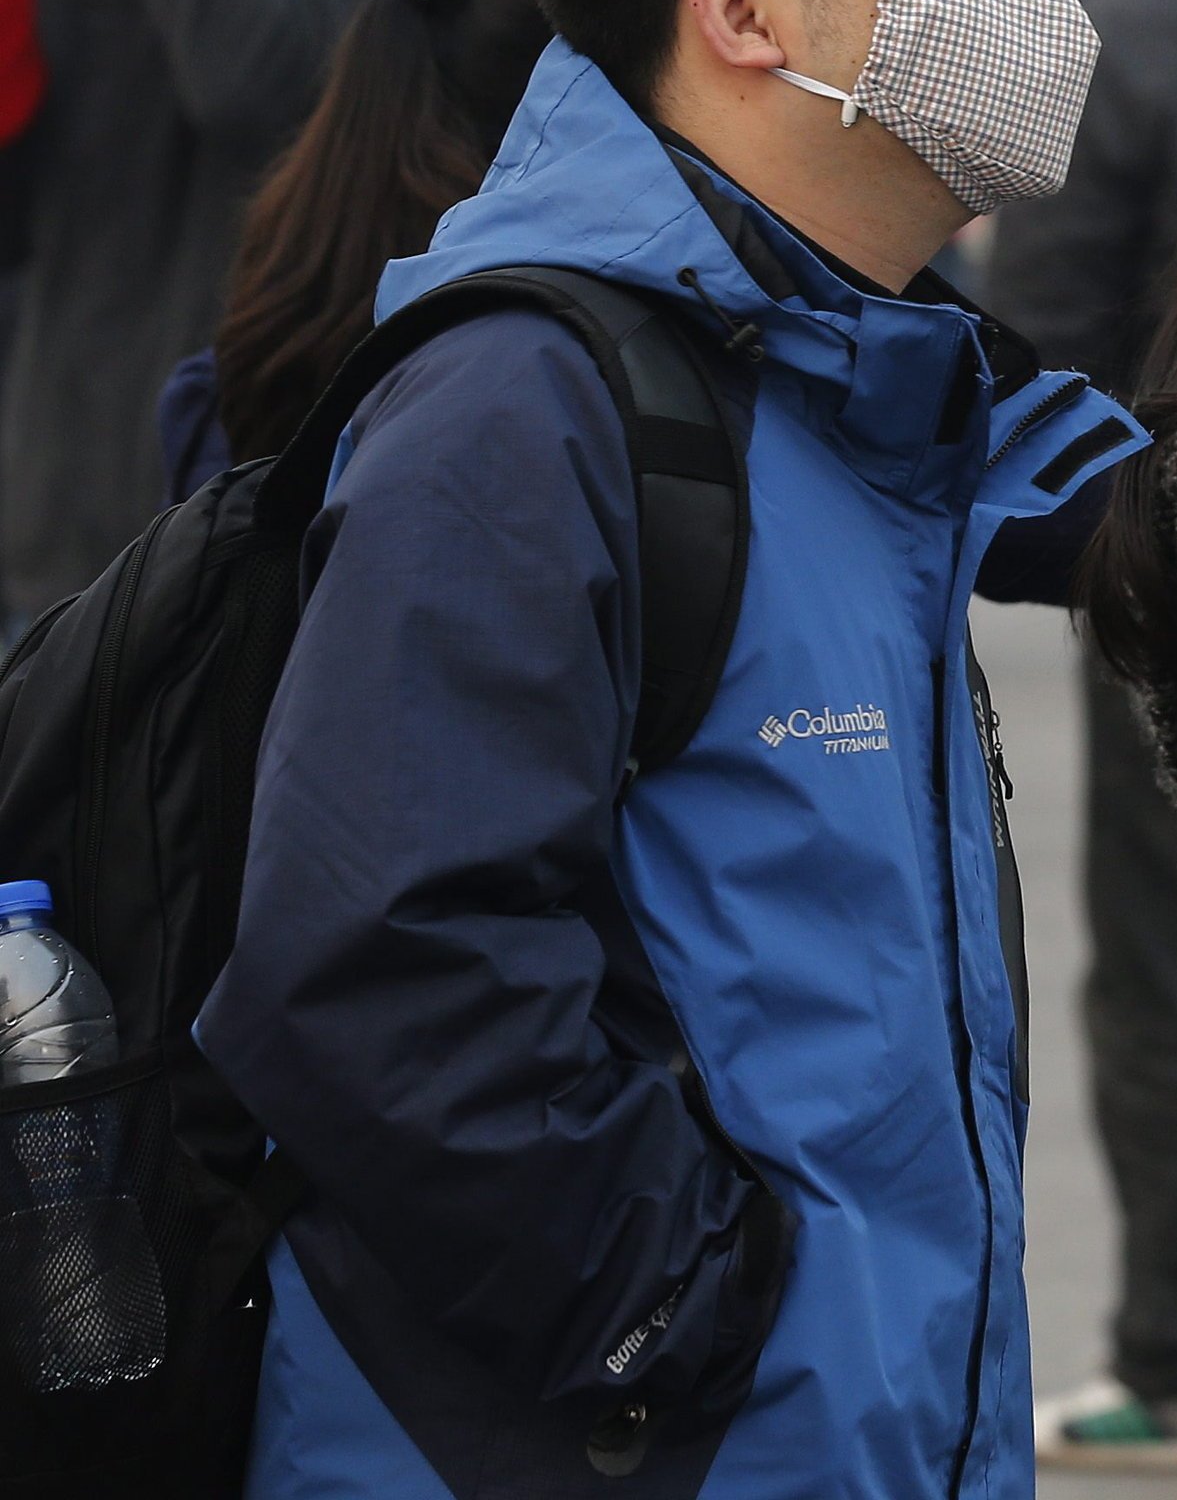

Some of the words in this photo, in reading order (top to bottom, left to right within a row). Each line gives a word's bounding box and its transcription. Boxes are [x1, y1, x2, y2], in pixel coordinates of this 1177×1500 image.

[787, 703, 887, 738] Columbia
[823, 734, 891, 755] TITANIUM
[973, 690, 1005, 847] TITANIUM
